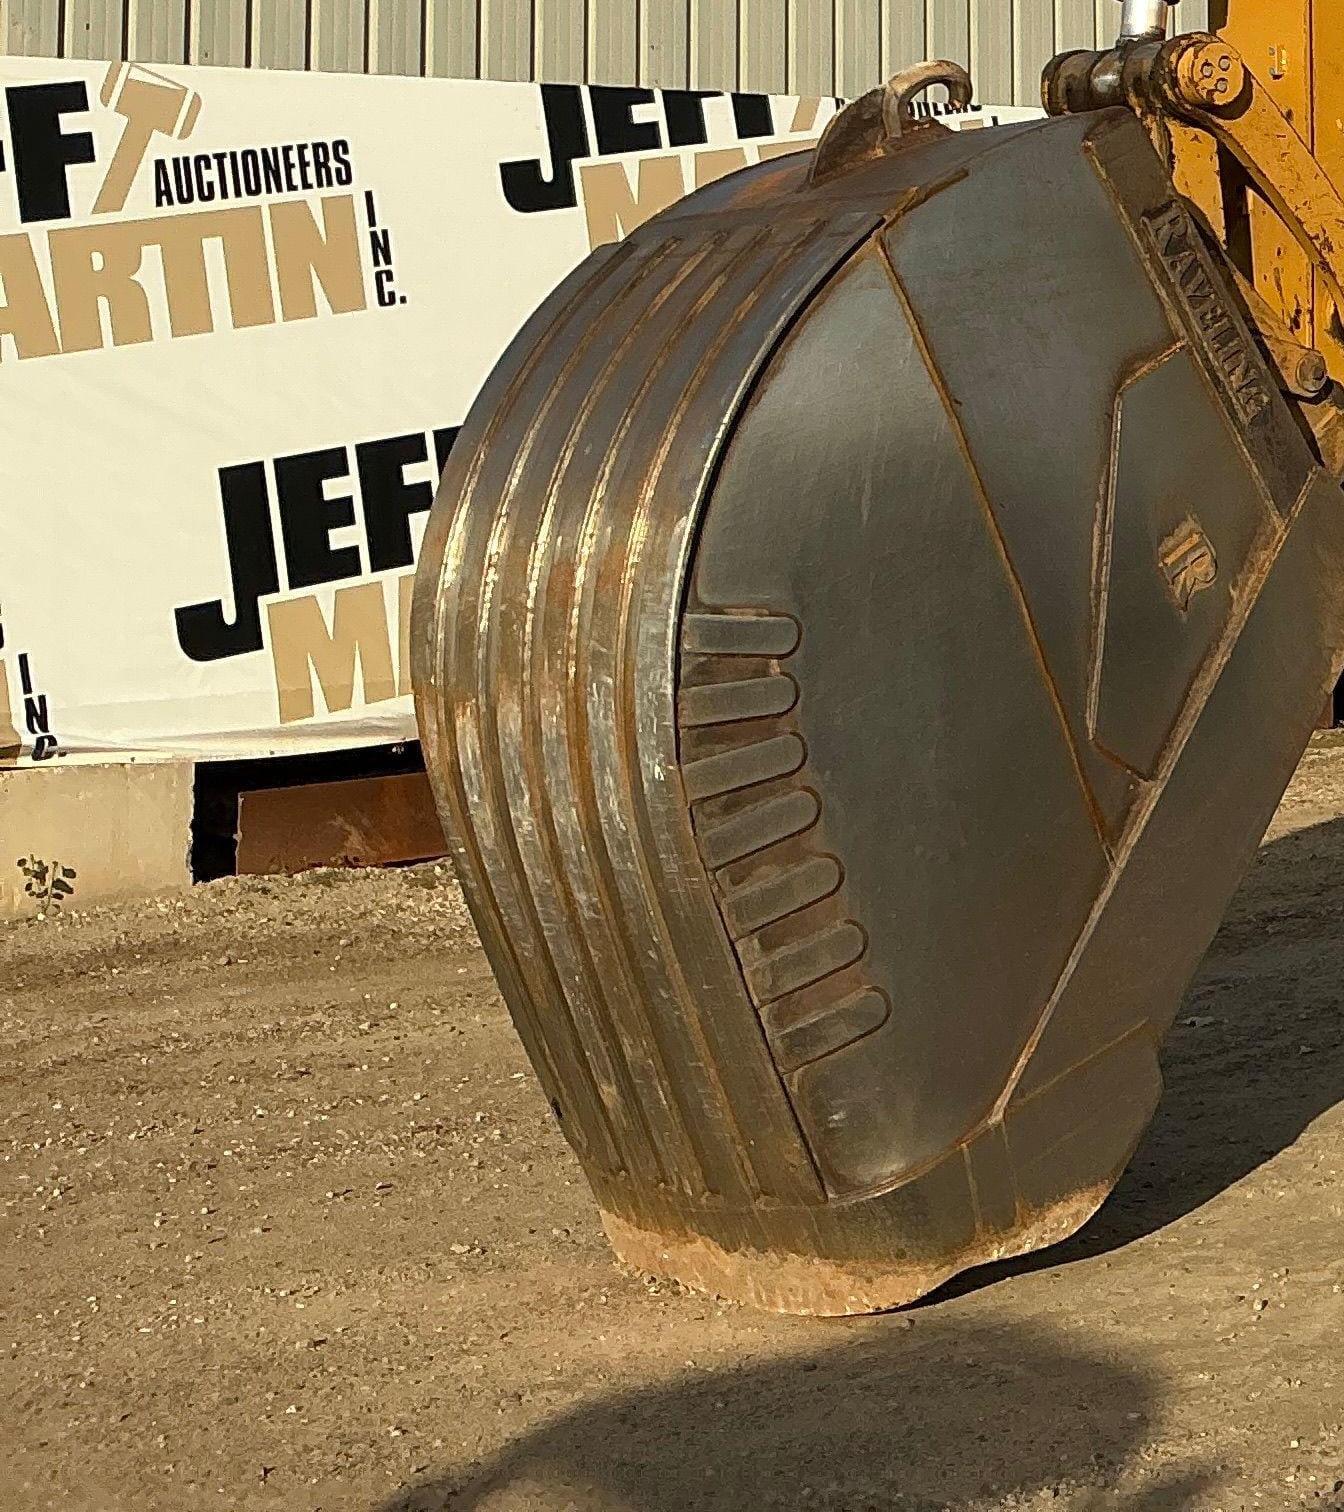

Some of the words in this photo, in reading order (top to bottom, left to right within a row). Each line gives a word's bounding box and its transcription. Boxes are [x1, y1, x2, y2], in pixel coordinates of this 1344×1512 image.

[155, 140, 353, 208] AUCTIONEERS
[364, 190, 407, 307] INC.
[174, 425, 464, 662] JEF
